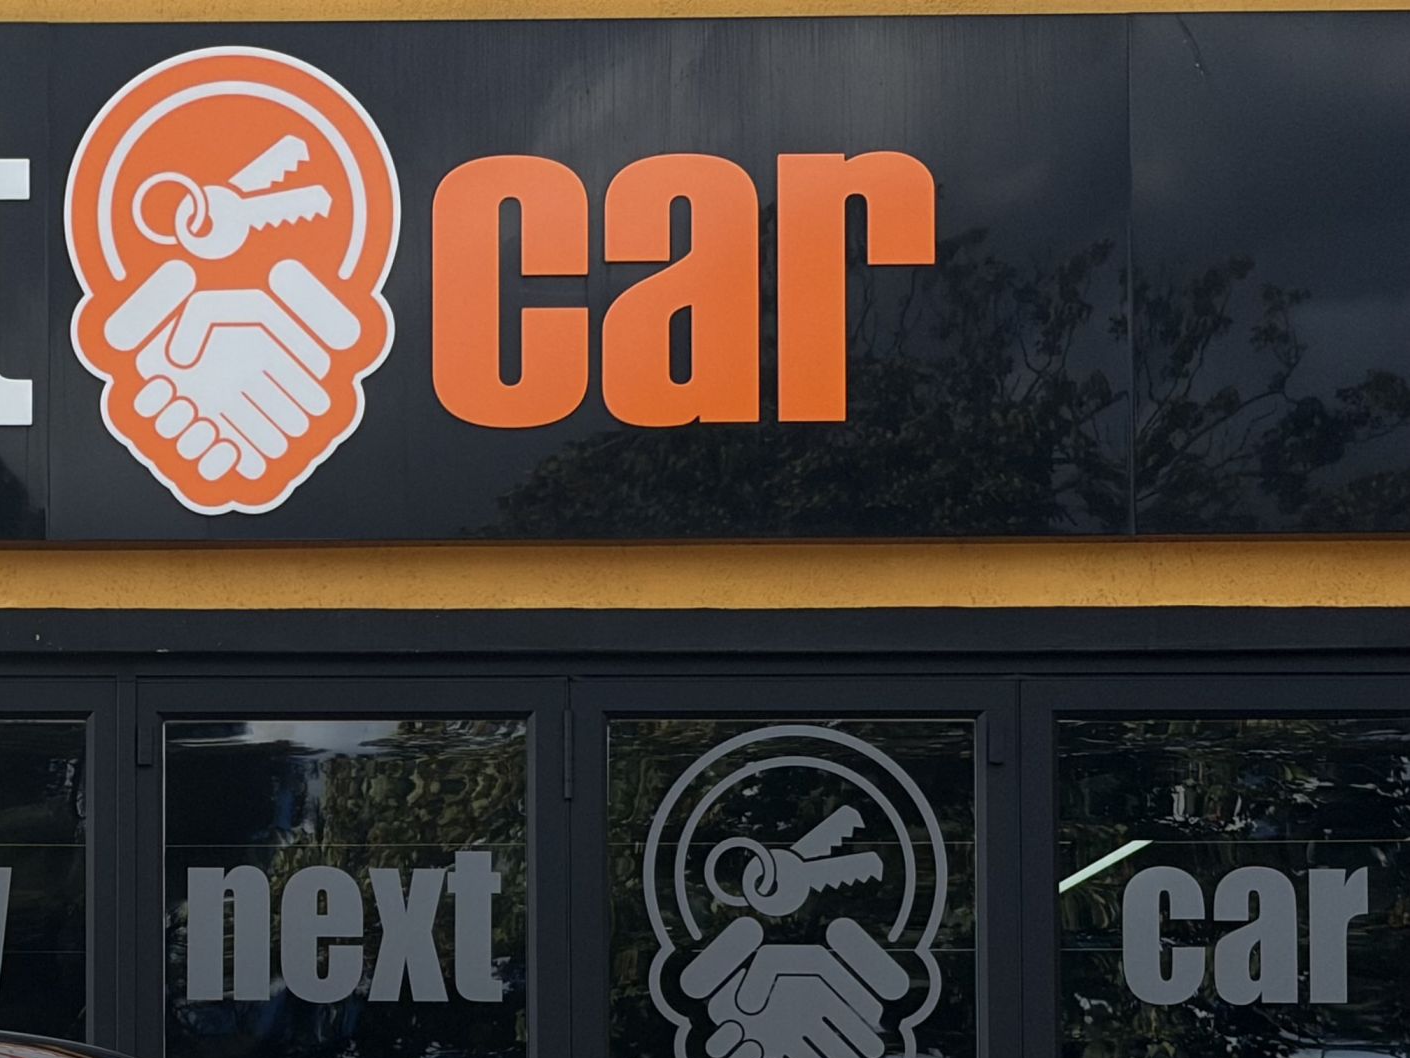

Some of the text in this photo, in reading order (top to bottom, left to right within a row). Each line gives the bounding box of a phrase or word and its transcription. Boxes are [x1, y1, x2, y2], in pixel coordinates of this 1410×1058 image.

[432, 151, 935, 428] car
[187, 851, 503, 1004] next
[1122, 866, 1368, 1006] car
